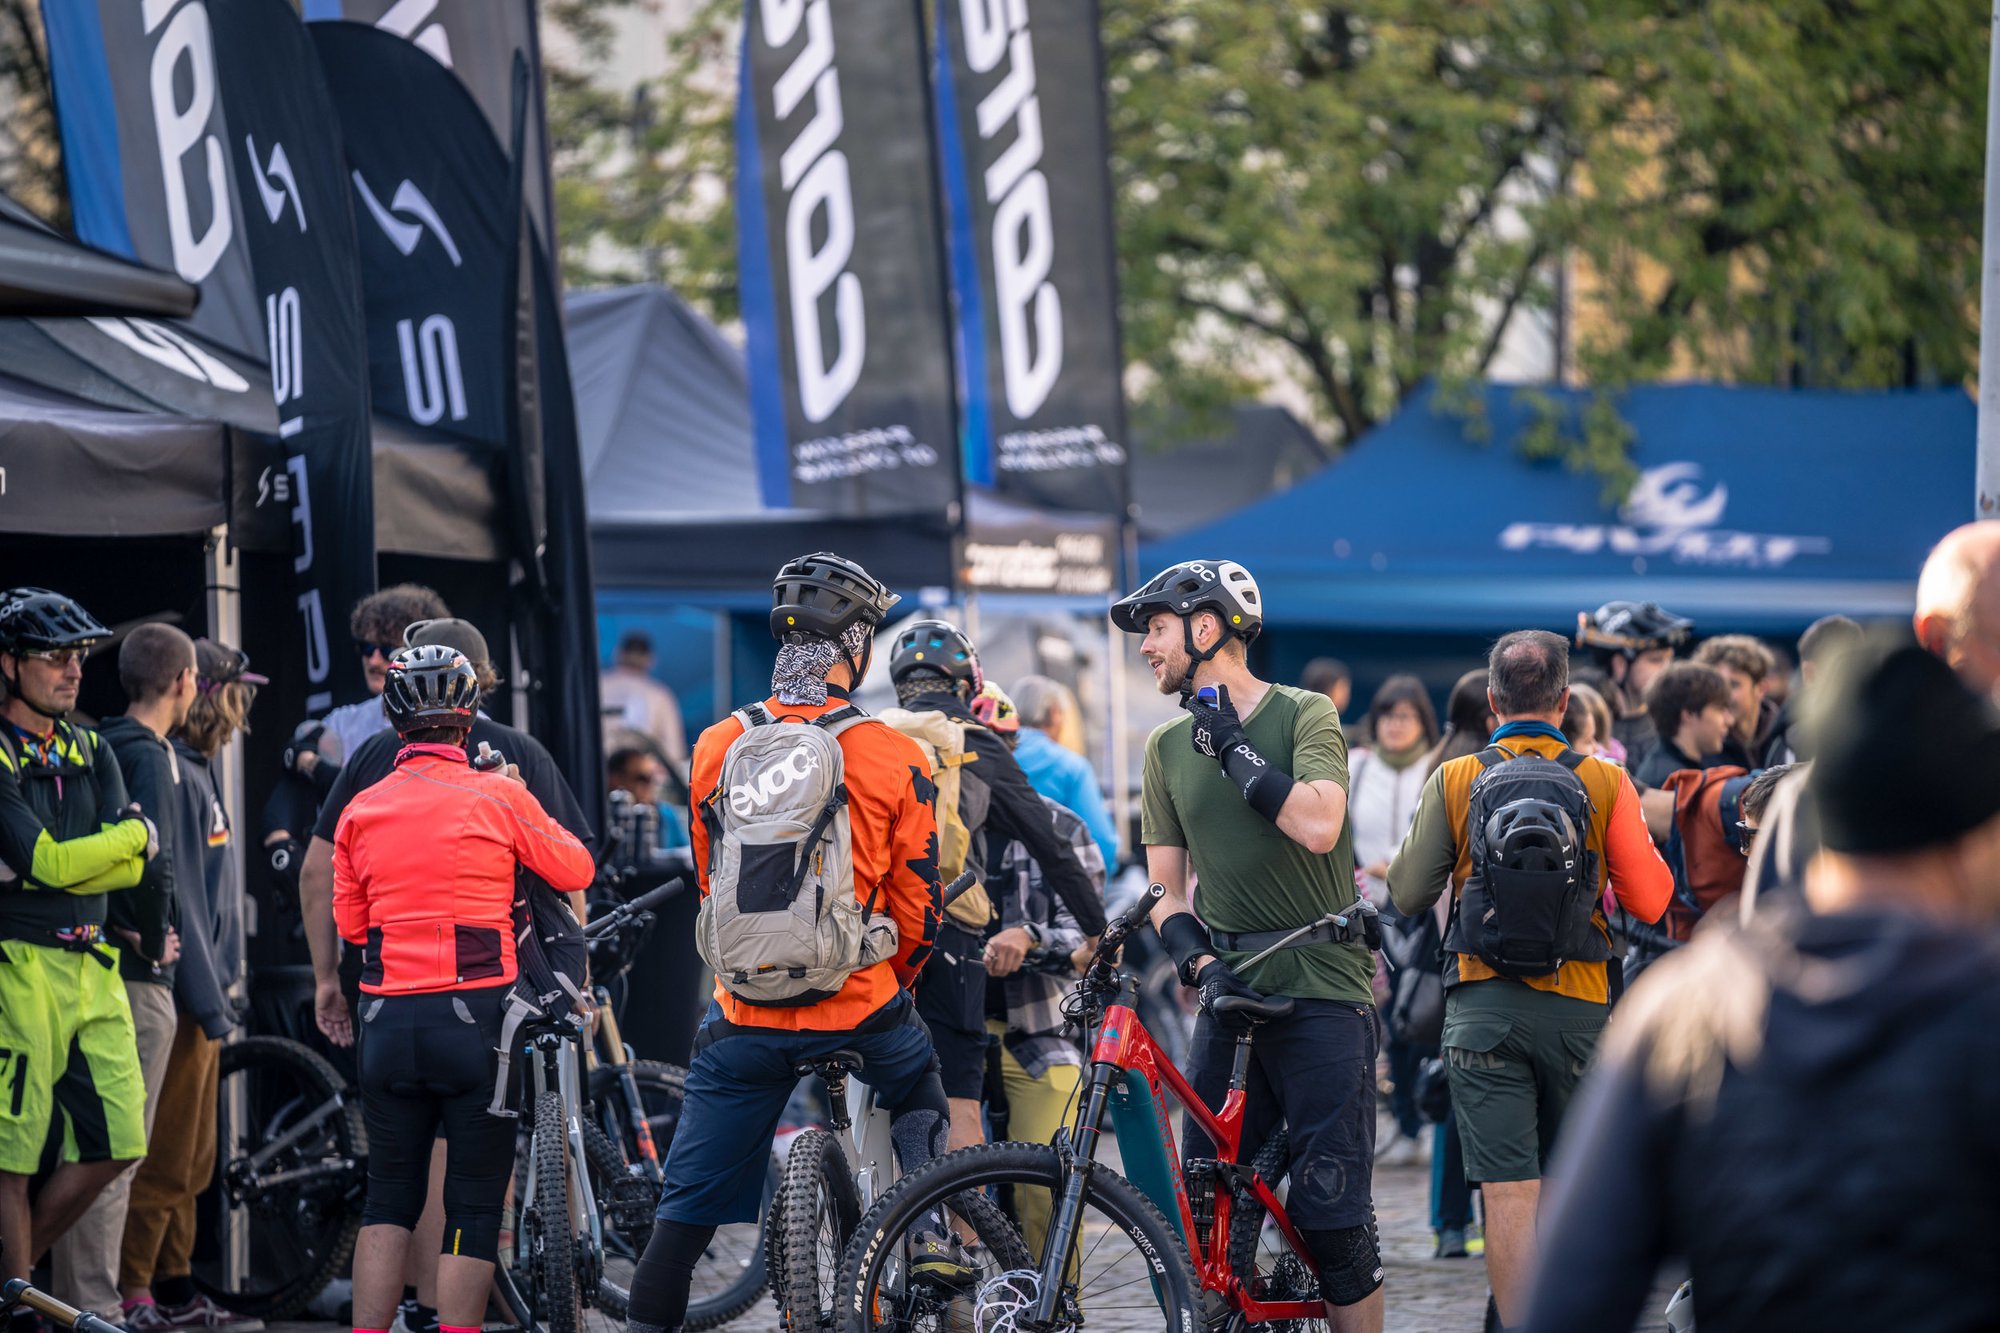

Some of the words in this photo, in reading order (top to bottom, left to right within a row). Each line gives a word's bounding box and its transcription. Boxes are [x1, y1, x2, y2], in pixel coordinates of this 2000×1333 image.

[863, 608, 878, 624] SMITH
[1234, 744, 1266, 767] POC
[730, 746, 812, 816] evoc
[1129, 1226, 1156, 1256] SWISS
[854, 1228, 884, 1313] MAXXIS
[1150, 1257, 1166, 1274] DT
